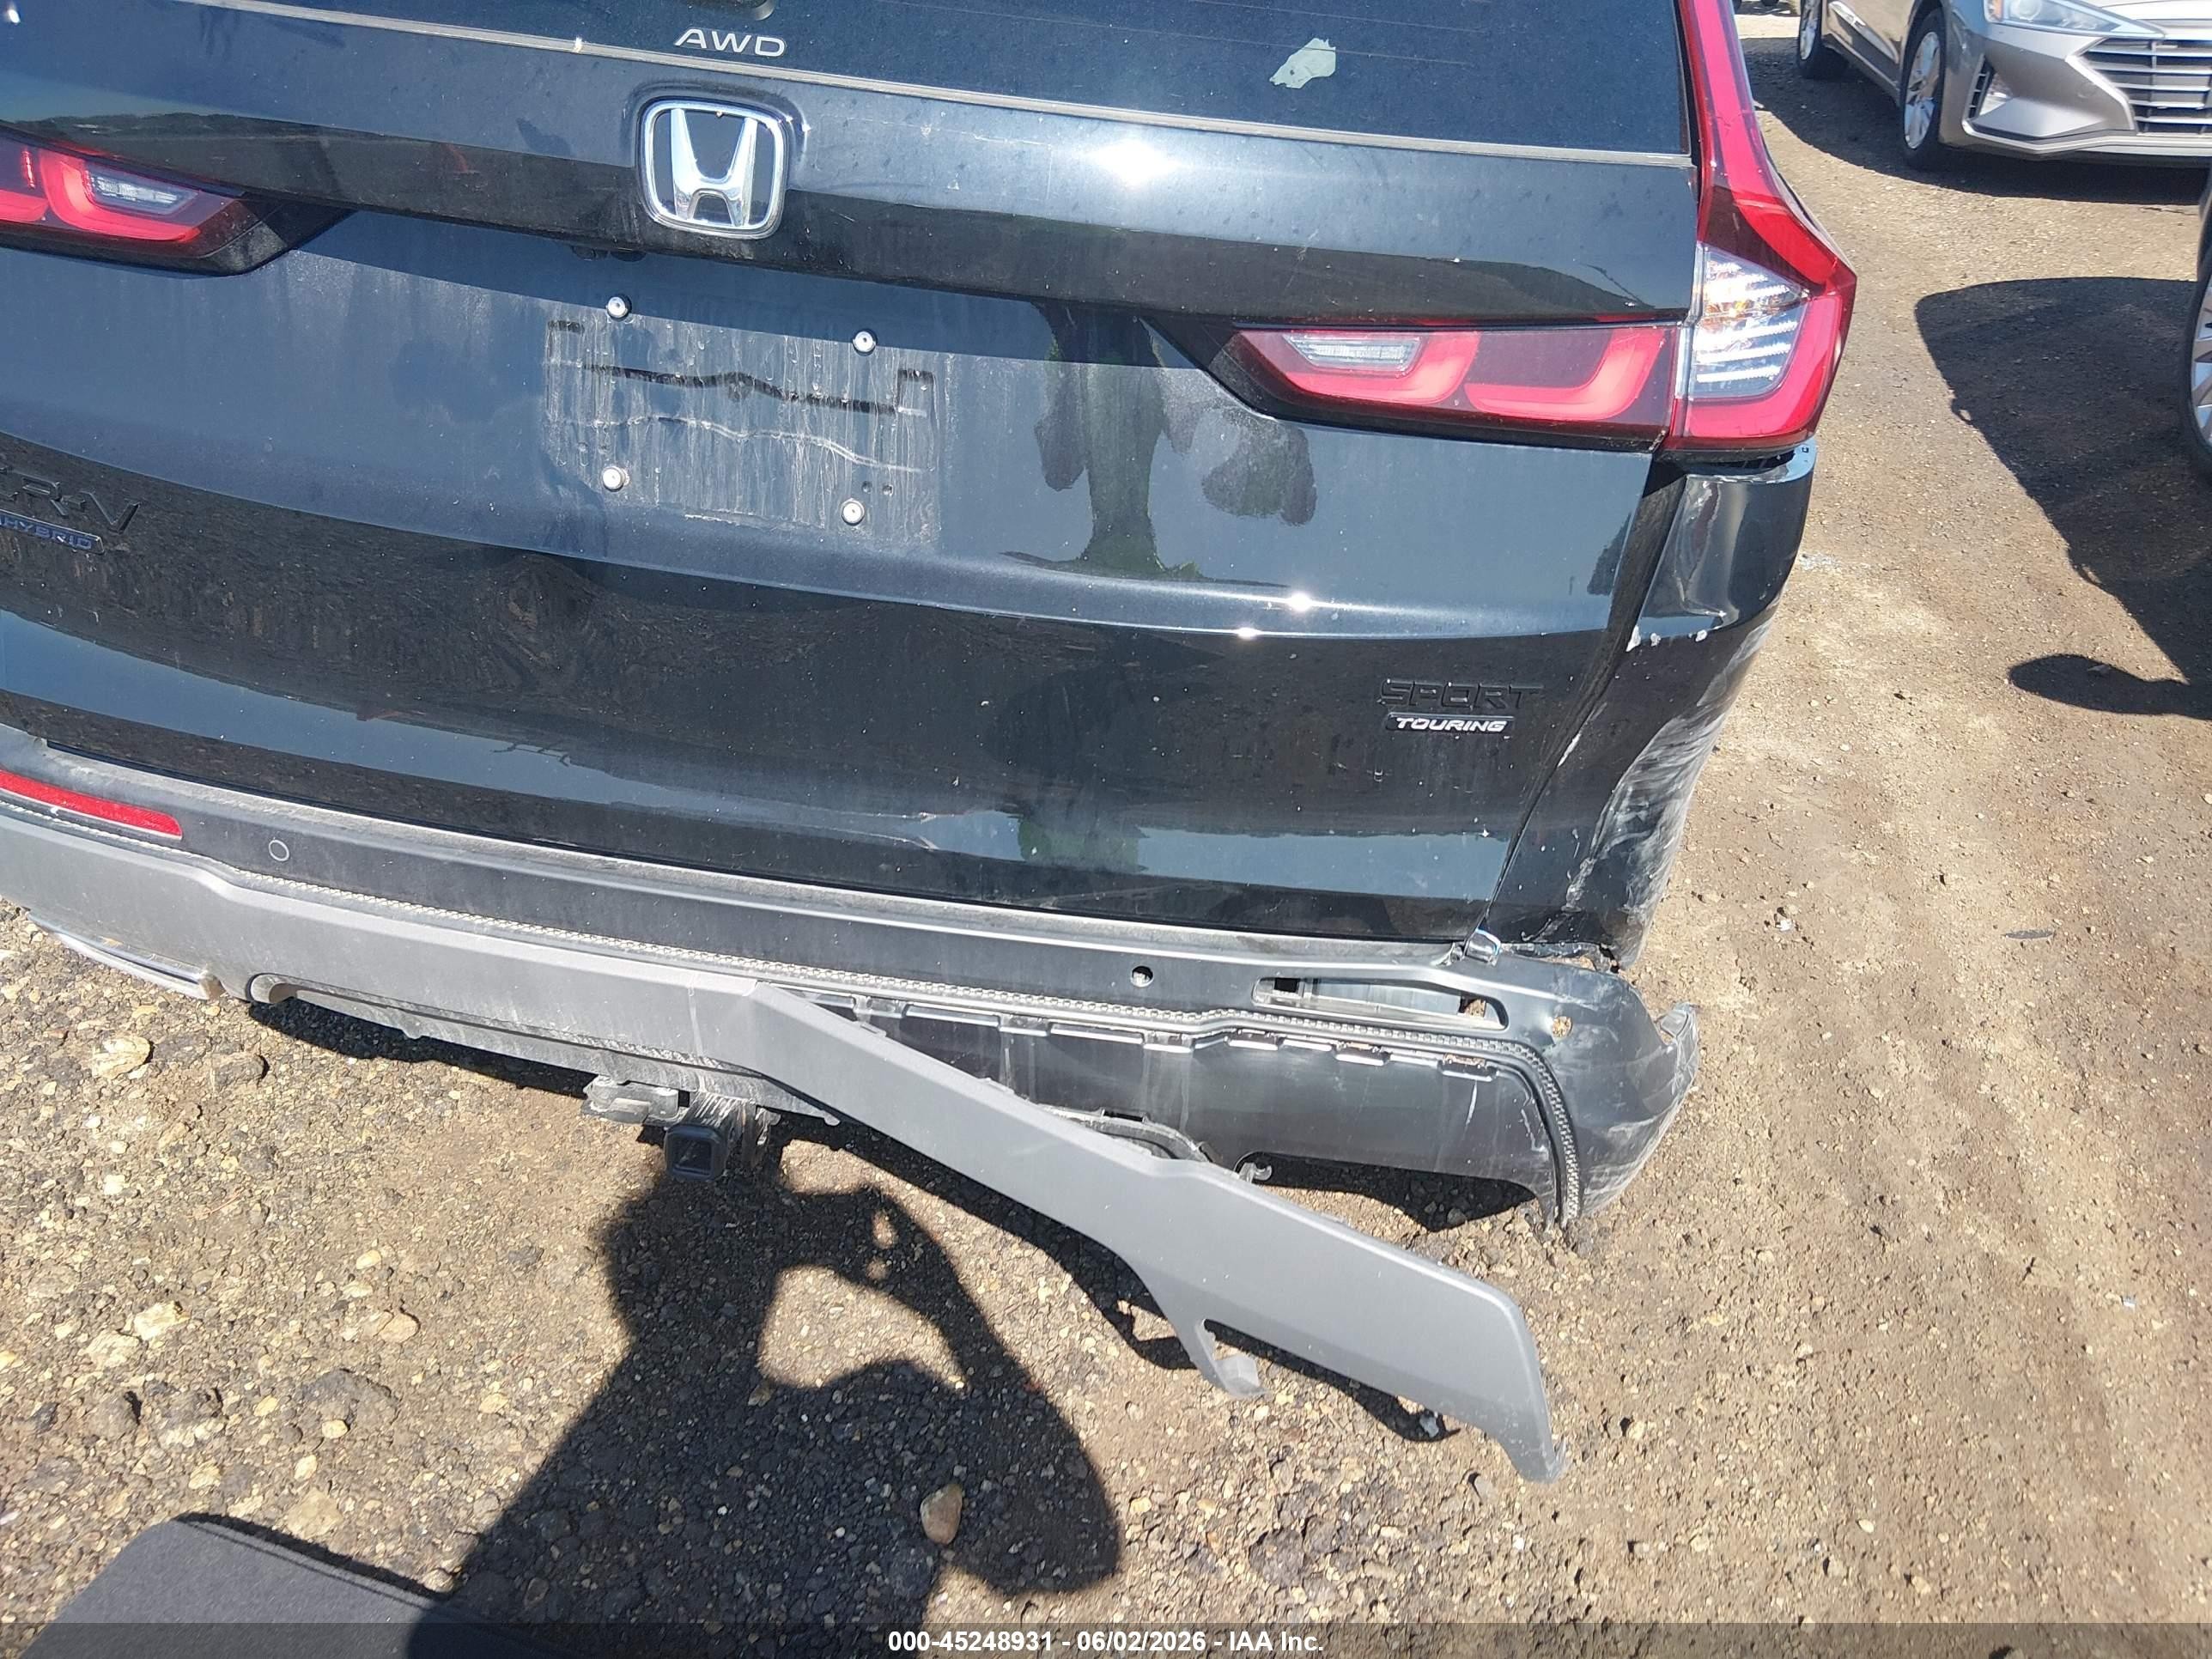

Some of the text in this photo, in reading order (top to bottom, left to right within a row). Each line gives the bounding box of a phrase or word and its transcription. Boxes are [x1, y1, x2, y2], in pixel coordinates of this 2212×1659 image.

[674, 28, 787, 57] AWD
[4, 517, 92, 550] HYBRID
[1377, 678, 1544, 709] SPORT
[1395, 717, 1508, 732] TOURING
